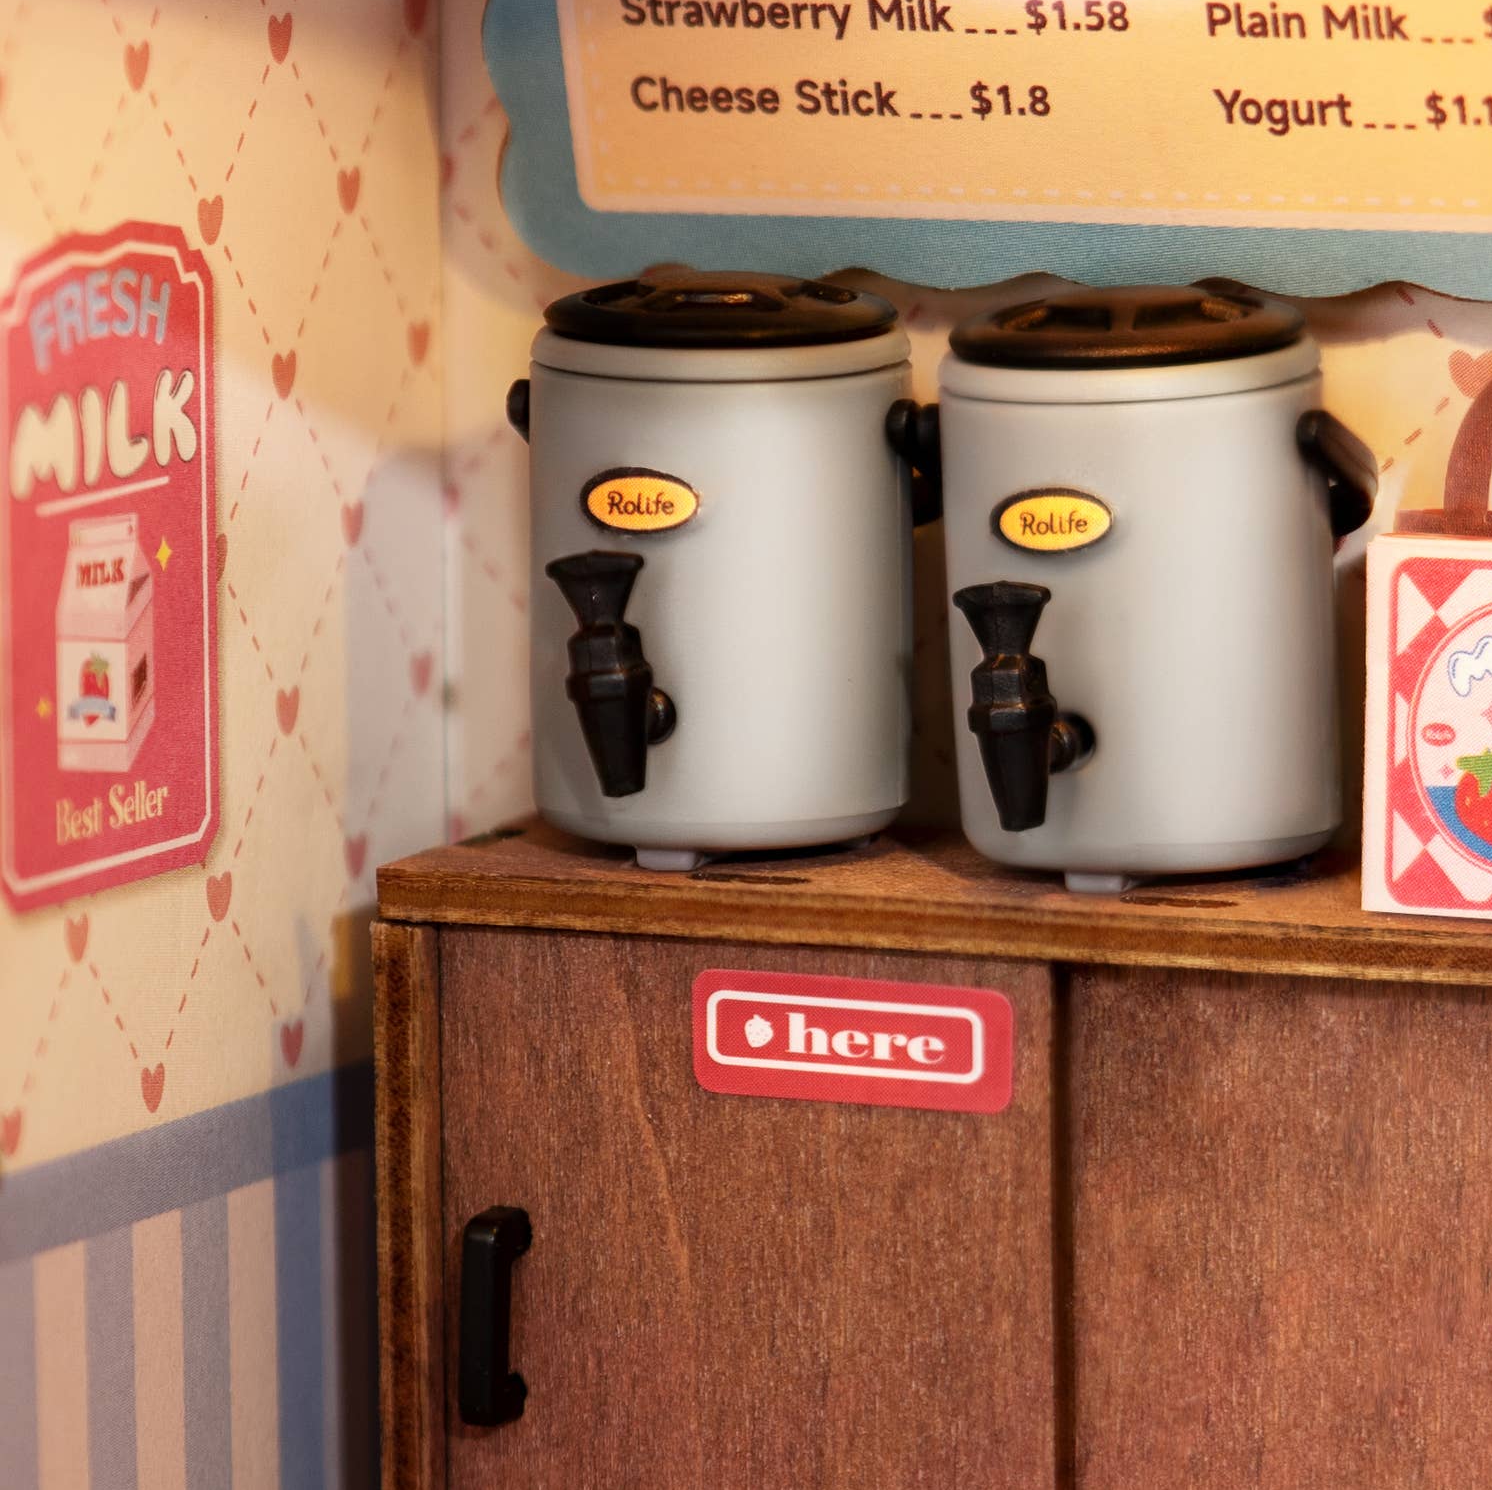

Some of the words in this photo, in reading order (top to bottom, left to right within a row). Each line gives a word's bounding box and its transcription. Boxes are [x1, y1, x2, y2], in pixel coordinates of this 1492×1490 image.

[1206, 2, 1306, 40] Plain
[1323, 5, 1410, 41] Milk
[630, 76, 780, 114] Cheese
[795, 79, 900, 117] Stick
[969, 81, 1051, 120] $1.8
[1213, 89, 1353, 136] Yogurt
[29, 267, 171, 373] FRESH
[9, 368, 197, 501] MILK
[607, 490, 675, 515] Rolife
[1019, 510, 1088, 536] Rolife
[75, 556, 125, 589] MILK
[56, 796, 103, 846] Best
[108, 780, 168, 830] Seller
[785, 1011, 945, 1065] here
